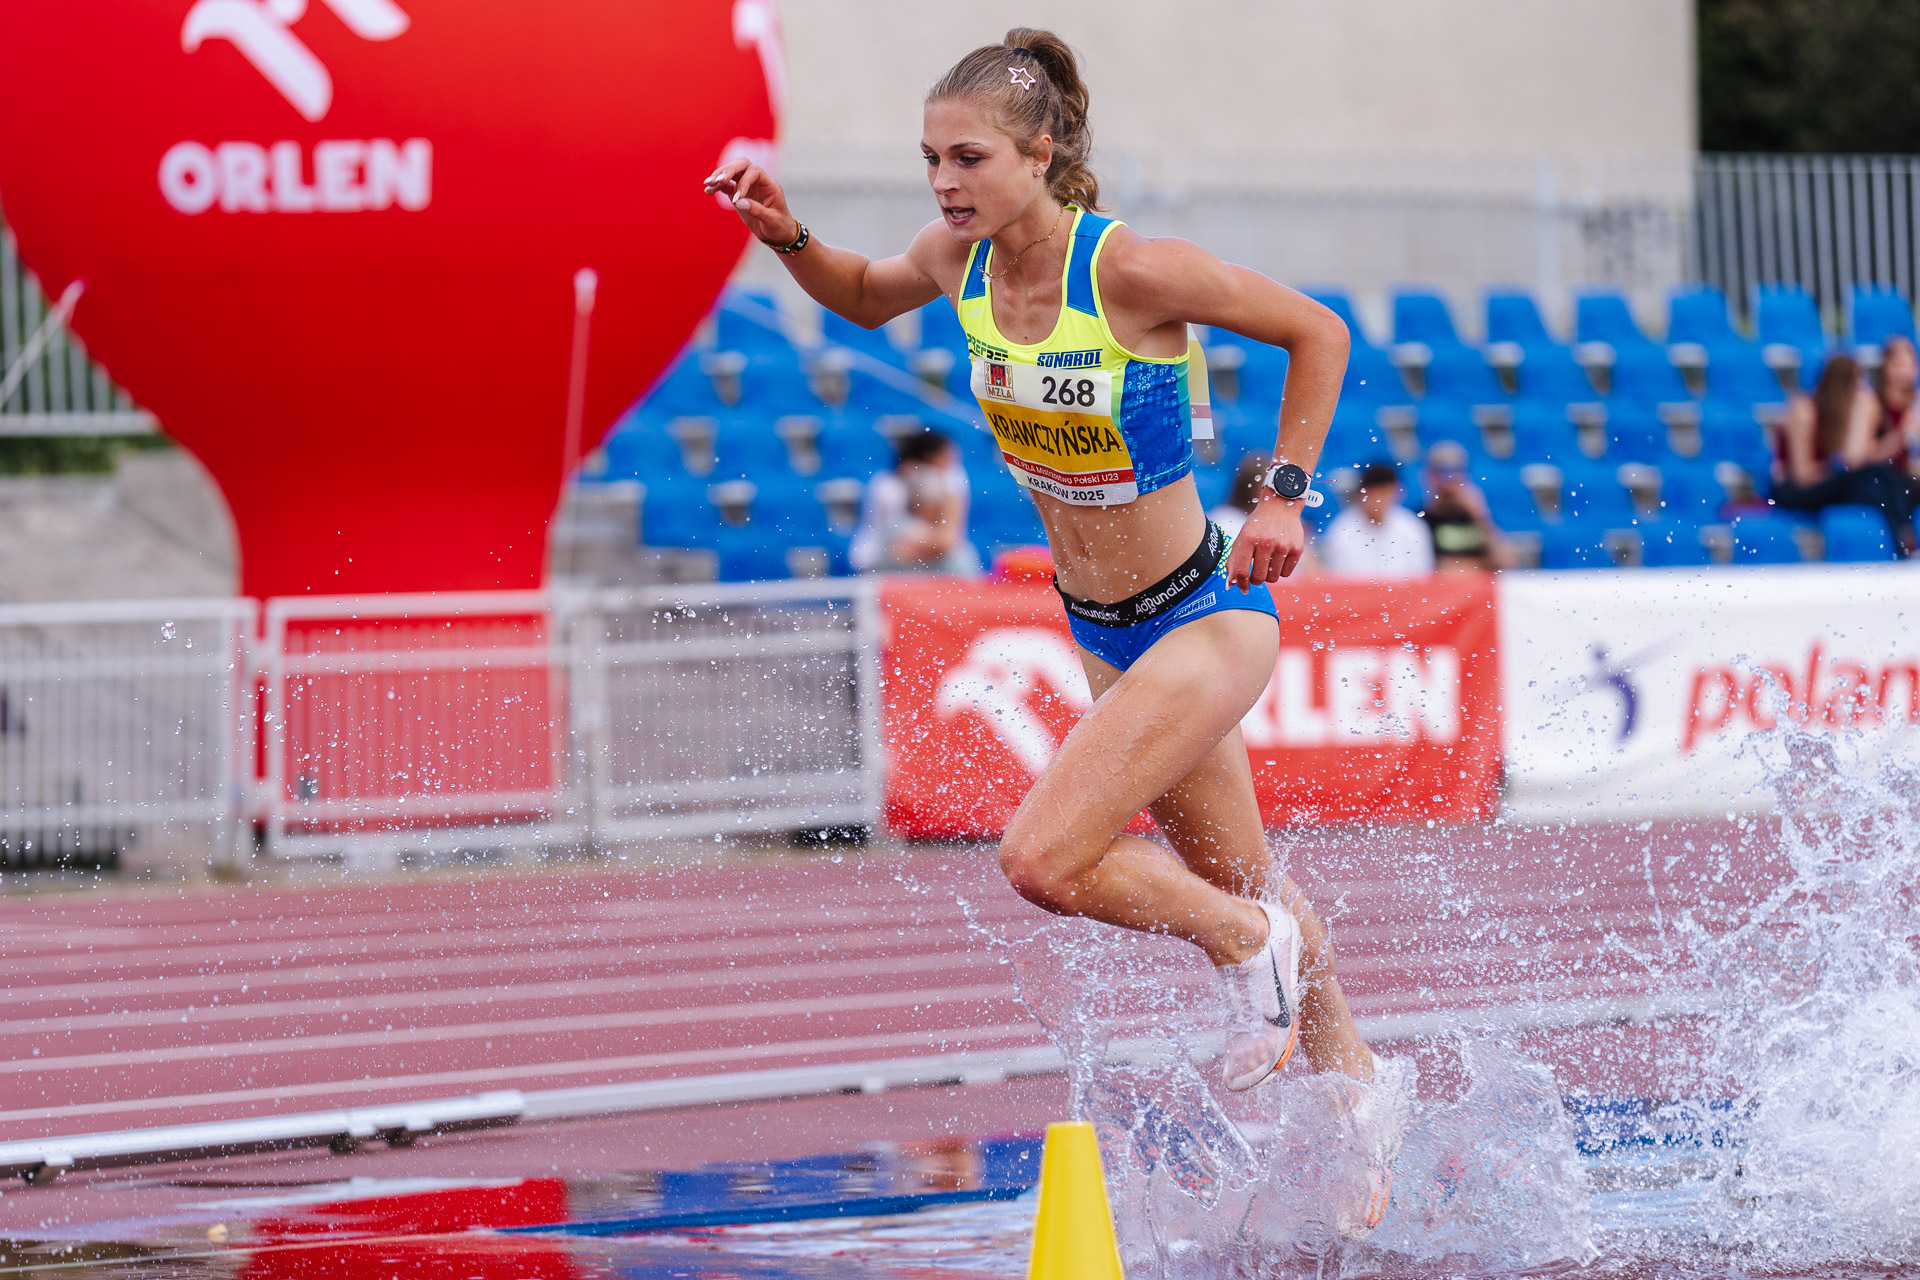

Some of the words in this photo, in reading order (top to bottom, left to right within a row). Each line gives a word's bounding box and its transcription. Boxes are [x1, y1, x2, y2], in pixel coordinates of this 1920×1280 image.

[157, 138, 433, 215] ORLEN
[1037, 348, 1103, 369] SONAROL
[987, 386, 1013, 400] MZLA
[1042, 376, 1095, 407] 268
[987, 411, 1123, 457] KRAWCZYŃSKA
[1027, 475, 1069, 500] KRAKÓW
[1071, 490, 1105, 501] 2025
[1073, 474, 1100, 485] Polski
[1101, 472, 1119, 482] U23
[1135, 568, 1200, 616] AdRunaLine
